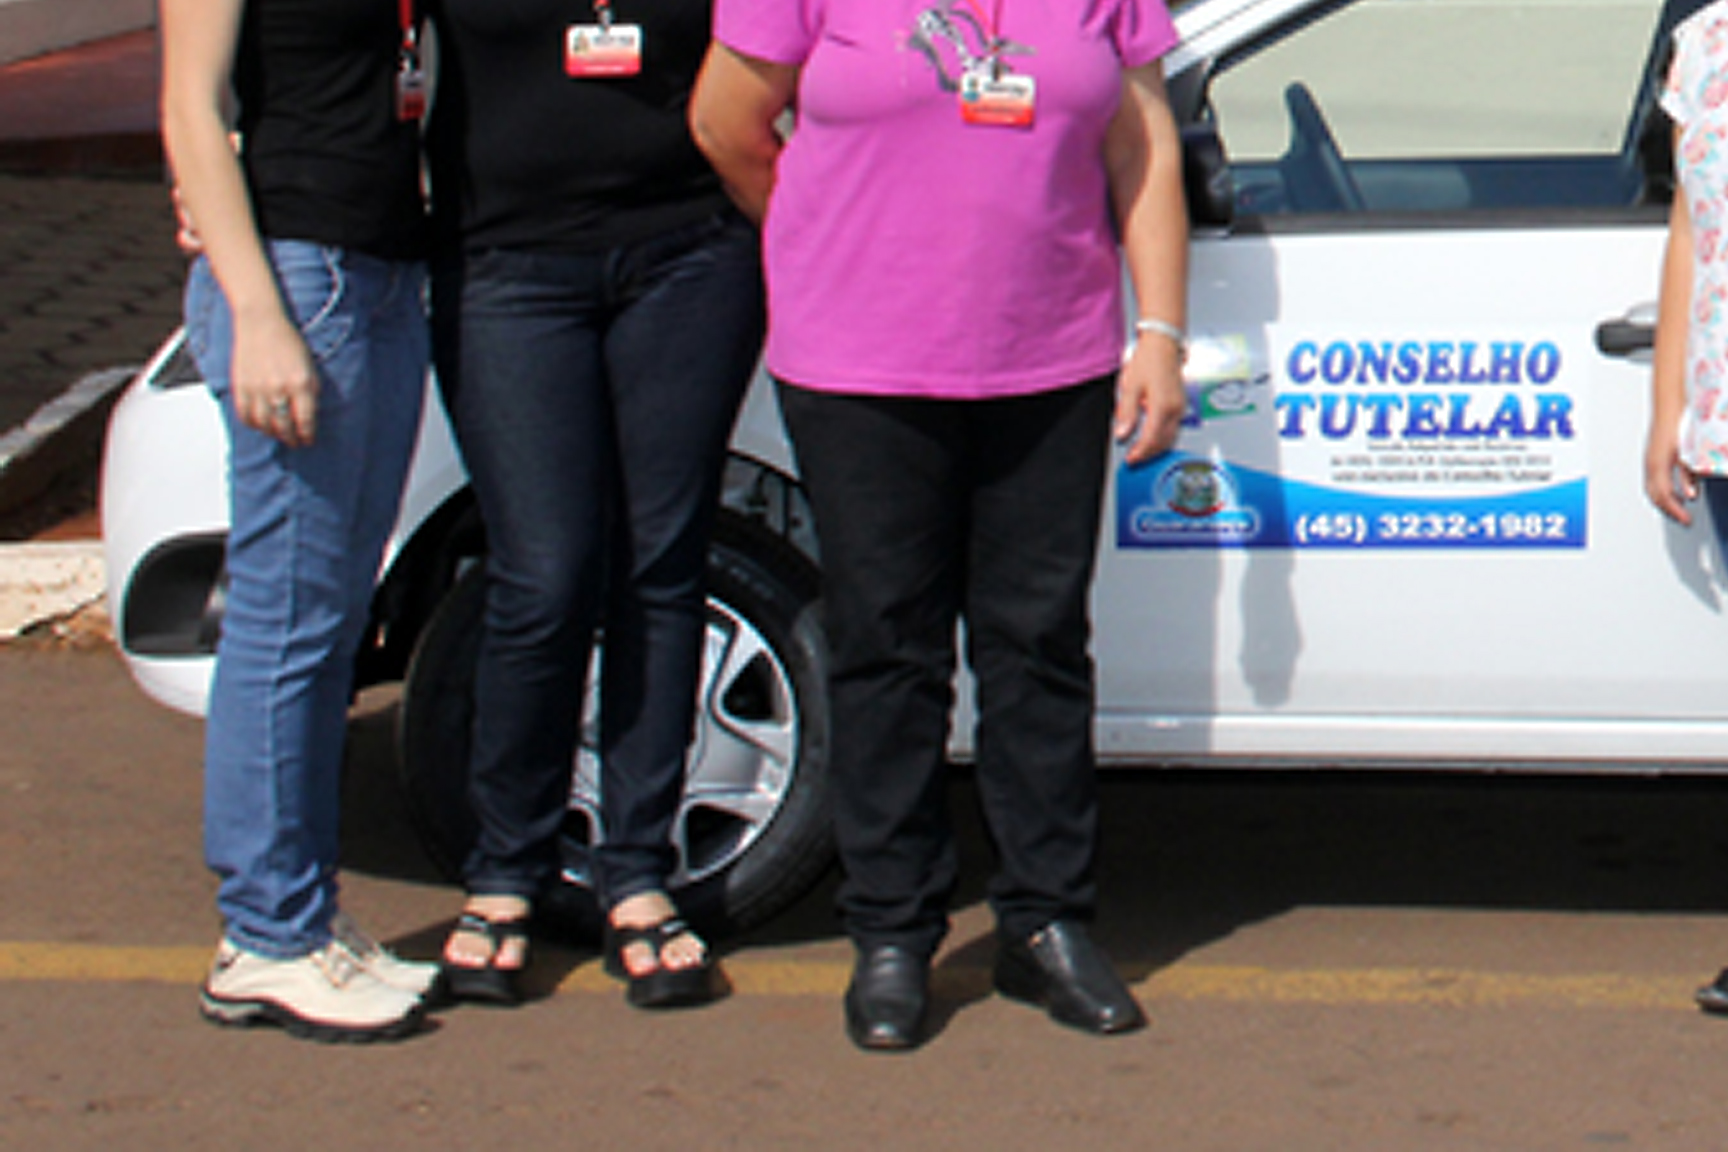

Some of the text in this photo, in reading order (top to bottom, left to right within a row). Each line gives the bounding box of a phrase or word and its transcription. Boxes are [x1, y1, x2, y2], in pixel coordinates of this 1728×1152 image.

[1286, 341, 1562, 386] CONSELHO
[1274, 392, 1575, 440] TUTELAR
[1294, 512, 1567, 544] (45) 3232-1982
